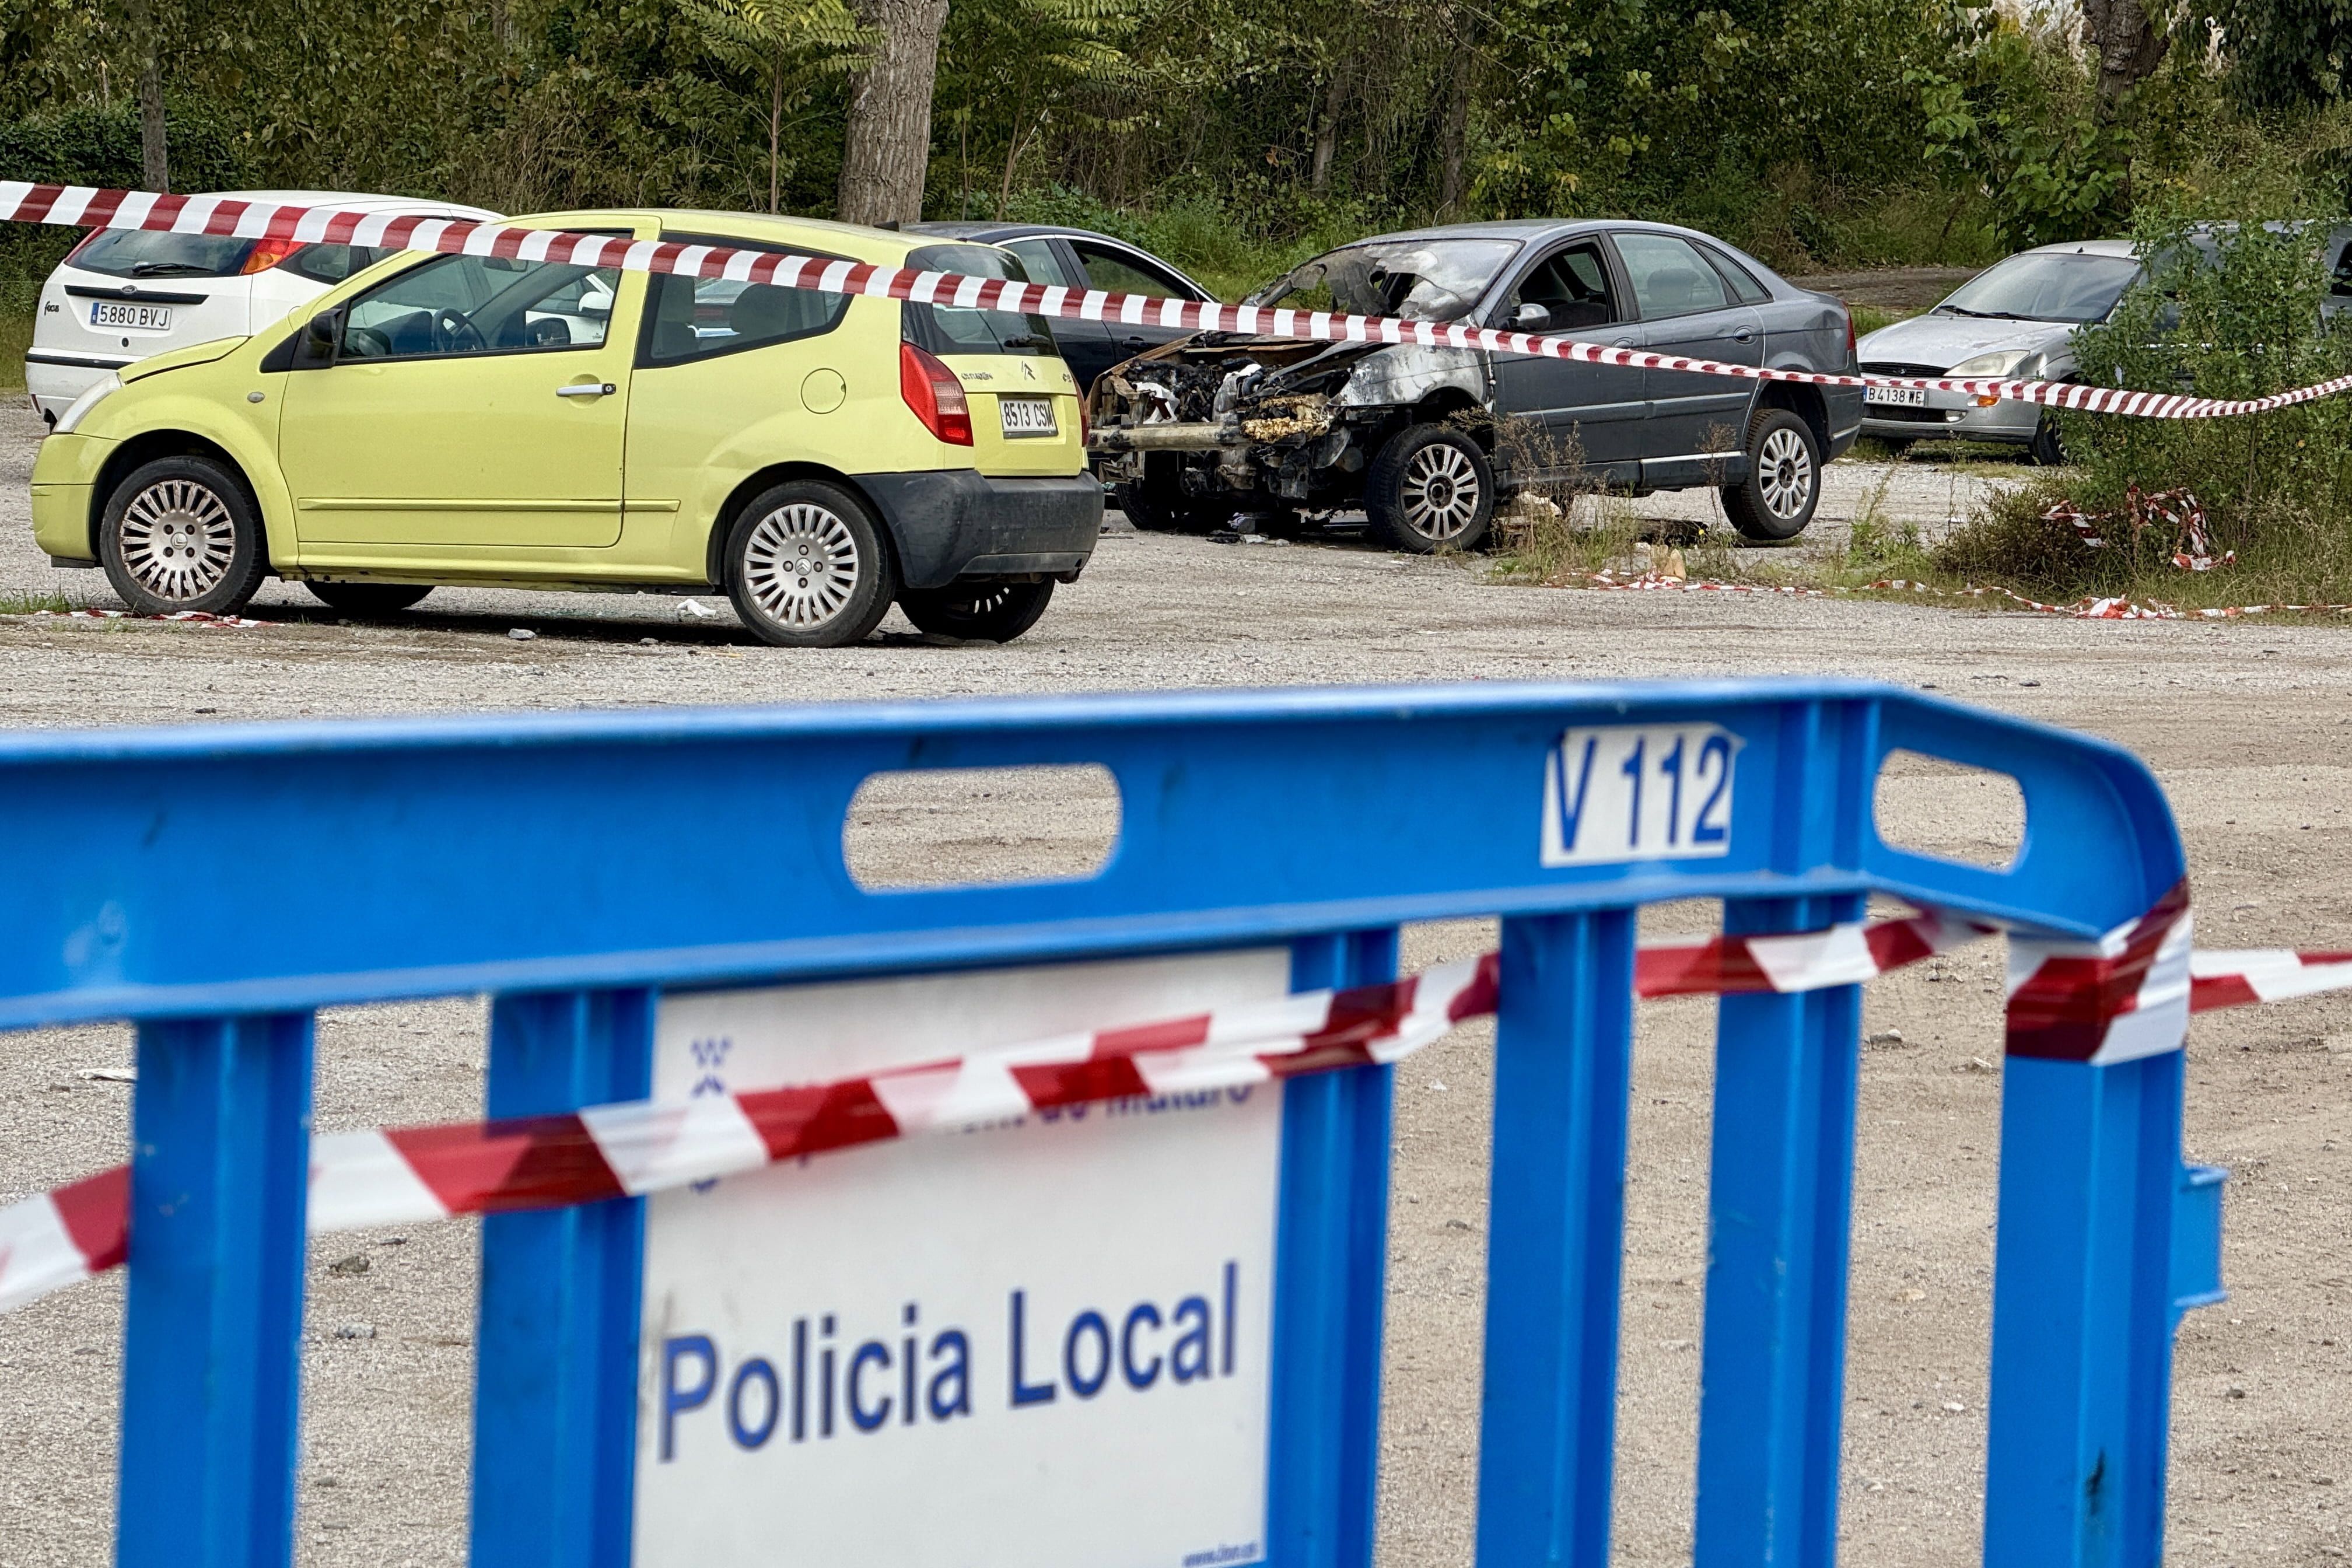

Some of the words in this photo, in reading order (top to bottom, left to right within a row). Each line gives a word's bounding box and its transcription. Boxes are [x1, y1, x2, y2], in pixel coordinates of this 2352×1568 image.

[100, 306, 136, 324] 5880
[139, 309, 168, 327] BVJ
[1004, 402, 1030, 426] 8513
[1556, 732, 1598, 852] V
[1621, 733, 1731, 848] 112
[656, 1301, 973, 1465] Policia
[1006, 1258, 1241, 1410] Local
